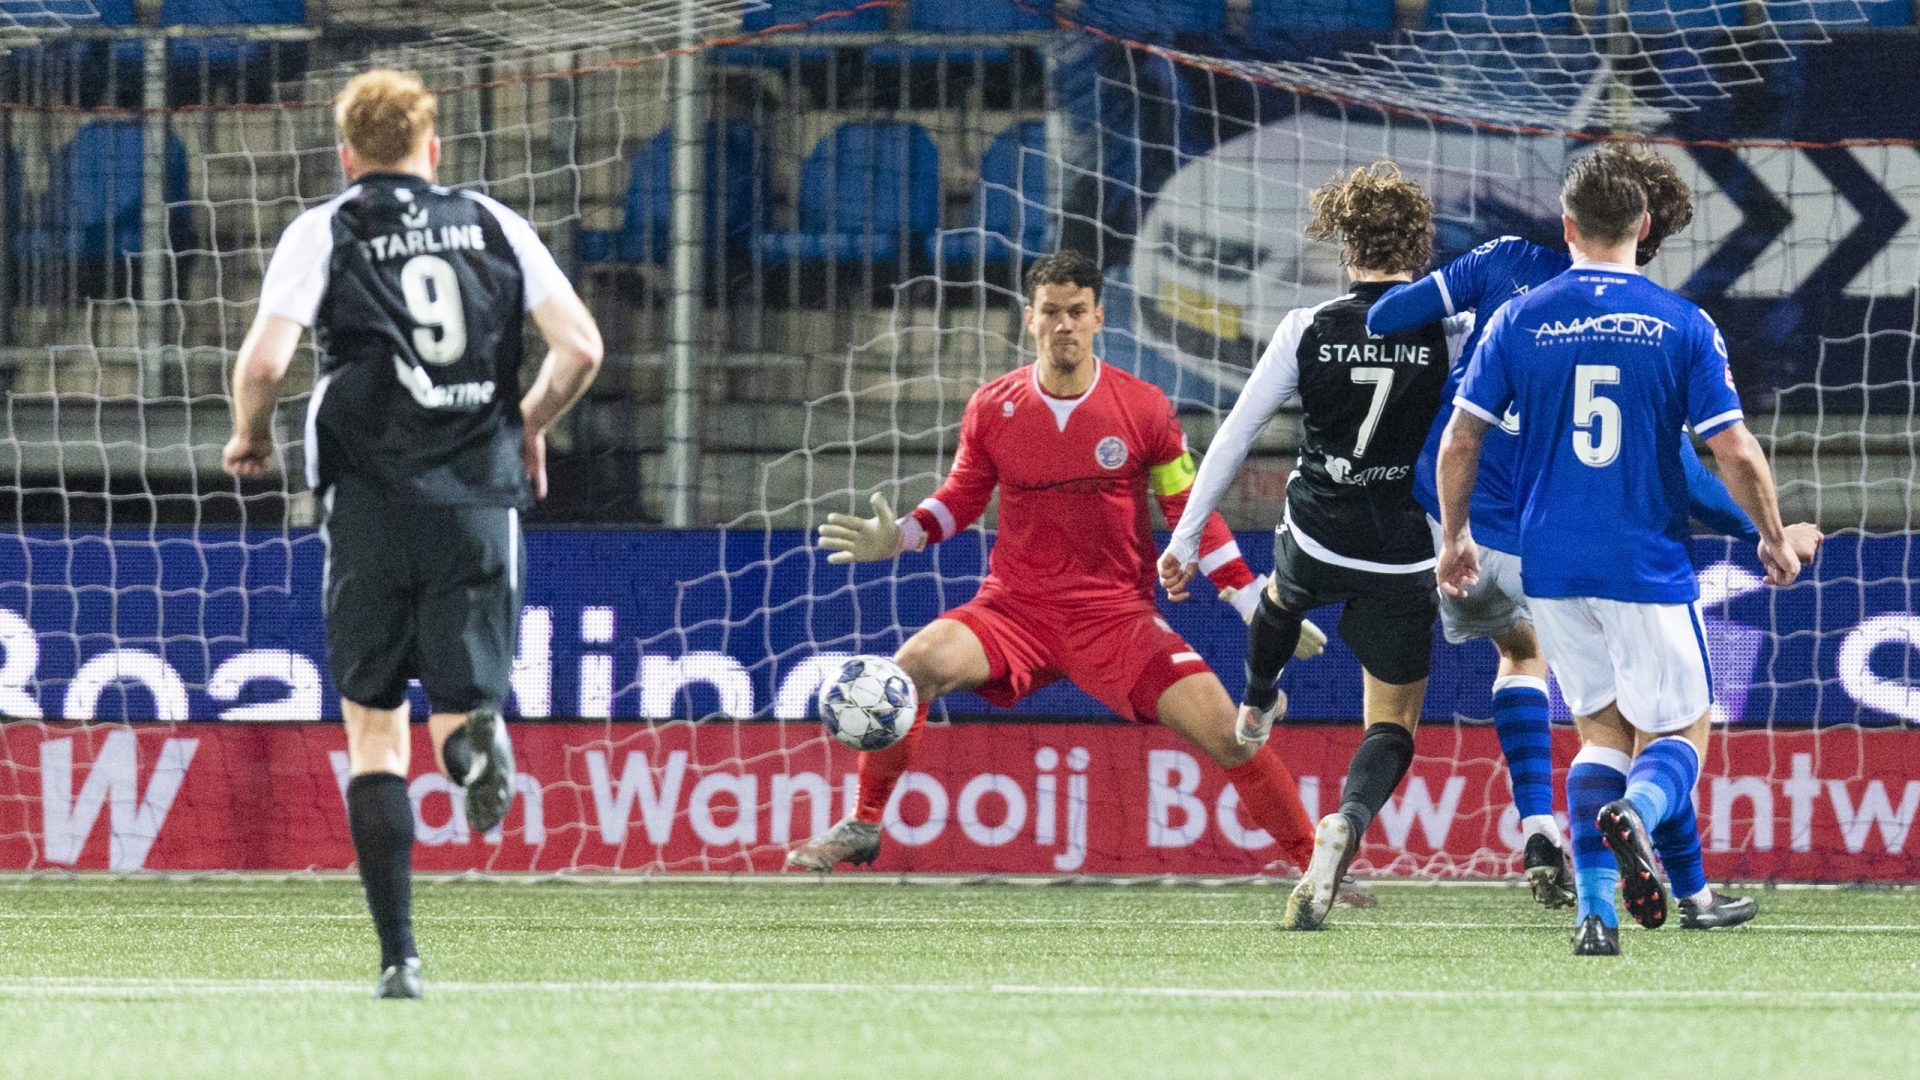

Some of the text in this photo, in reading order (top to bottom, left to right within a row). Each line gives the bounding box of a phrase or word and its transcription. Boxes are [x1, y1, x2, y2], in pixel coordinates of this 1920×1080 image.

[401, 254, 467, 366] 9
[1318, 344, 1431, 366] STARLINE
[1535, 314, 1665, 340] AMACOM
[1536, 335, 1662, 347] THE AMAZING COMPANY
[1350, 366, 1395, 459] 7
[1572, 364, 1622, 468] 5
[327, 750, 544, 846] an
[585, 749, 1089, 871] Wanooij
[1690, 752, 1920, 853] ntw
